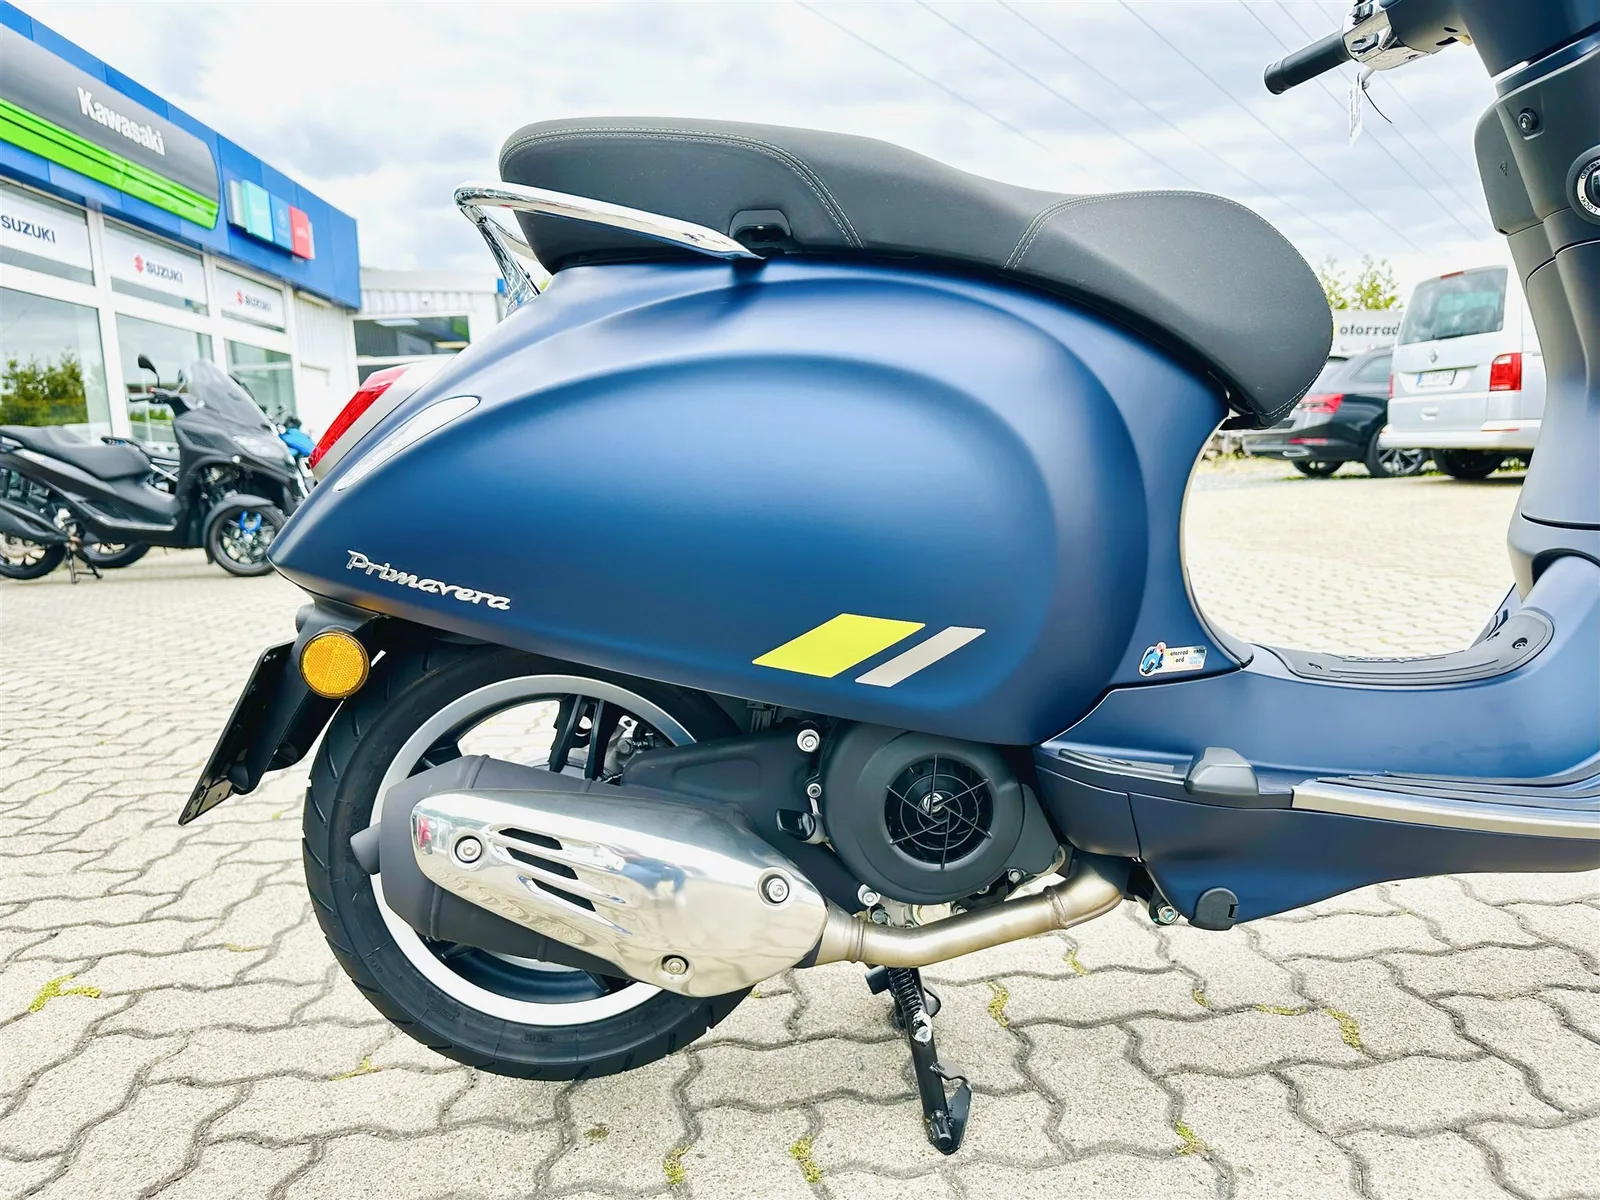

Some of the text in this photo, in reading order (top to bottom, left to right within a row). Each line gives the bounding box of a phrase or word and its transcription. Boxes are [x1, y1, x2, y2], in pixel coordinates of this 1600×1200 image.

[77, 86, 165, 156] Kawasaki
[1581, 197, 1597, 213] LOCK
[1, 215, 56, 244] SUZUKI
[145, 260, 183, 284] SUZUKI
[244, 294, 272, 312] SUZUKI
[1334, 321, 1400, 335] otorrad
[346, 549, 511, 610] Primavera
